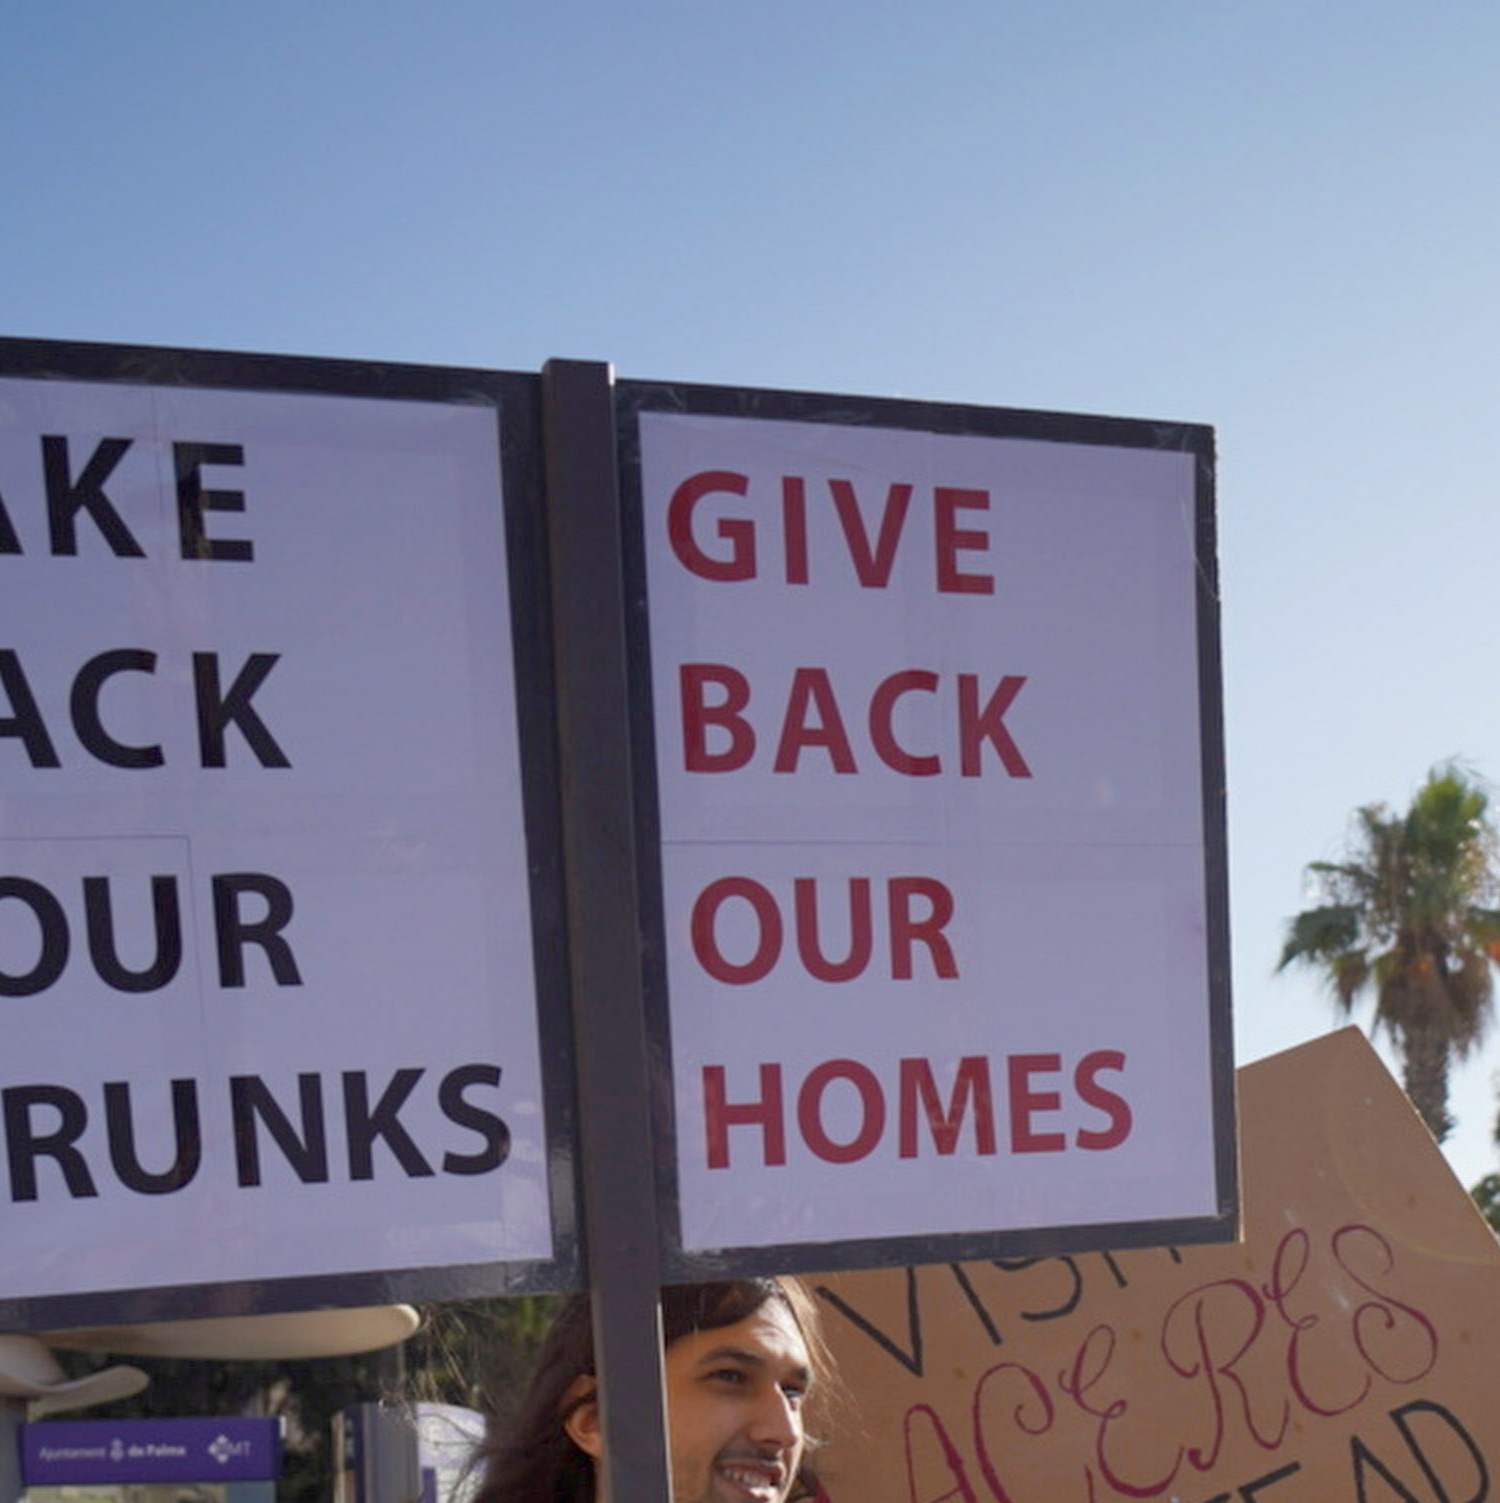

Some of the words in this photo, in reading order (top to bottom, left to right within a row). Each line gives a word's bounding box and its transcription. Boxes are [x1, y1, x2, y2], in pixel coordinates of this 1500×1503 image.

[667, 470, 994, 595] GIVE
[679, 663, 1032, 778] BACK
[690, 876, 959, 985] OUR
[702, 1050, 1133, 1170] HOMES
